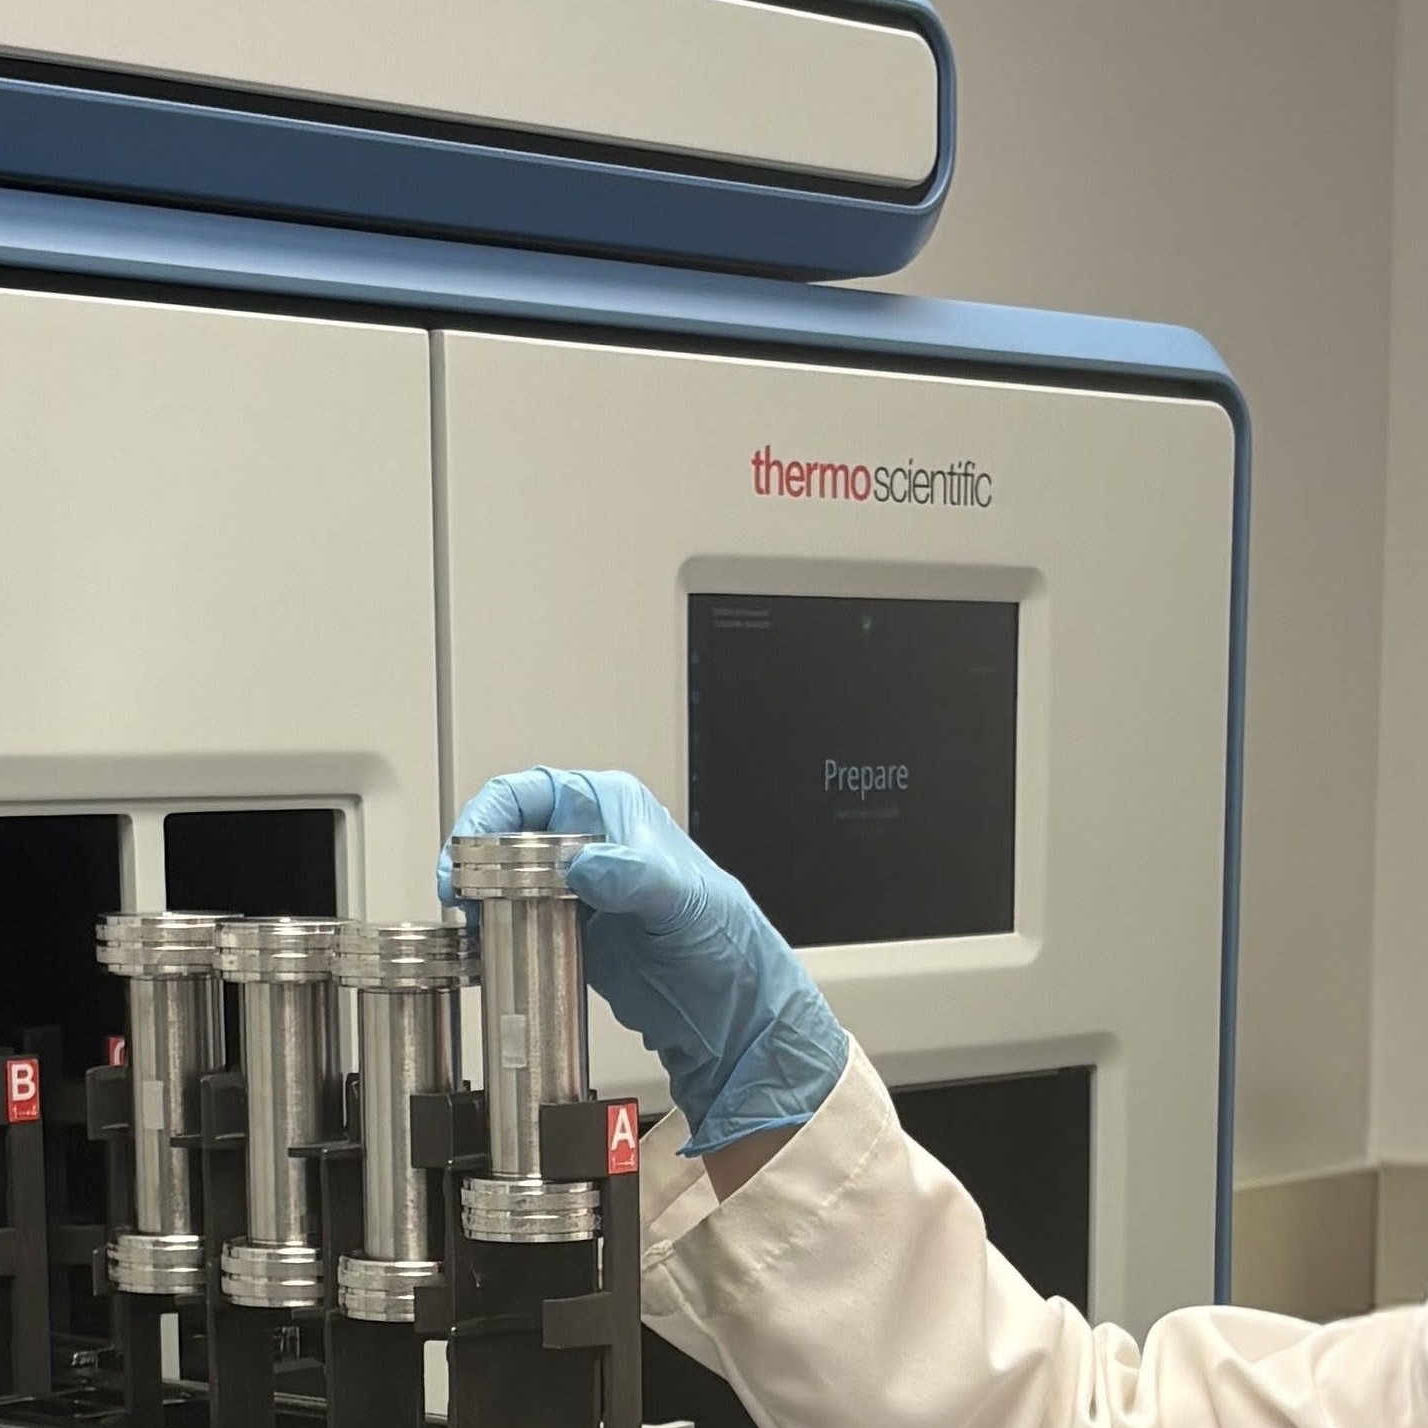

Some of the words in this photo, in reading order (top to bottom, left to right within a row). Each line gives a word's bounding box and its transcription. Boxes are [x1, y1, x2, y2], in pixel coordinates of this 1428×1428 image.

[824, 759, 909, 800] Prepare
[12, 1063, 36, 1101] B
[611, 1107, 635, 1150] A
